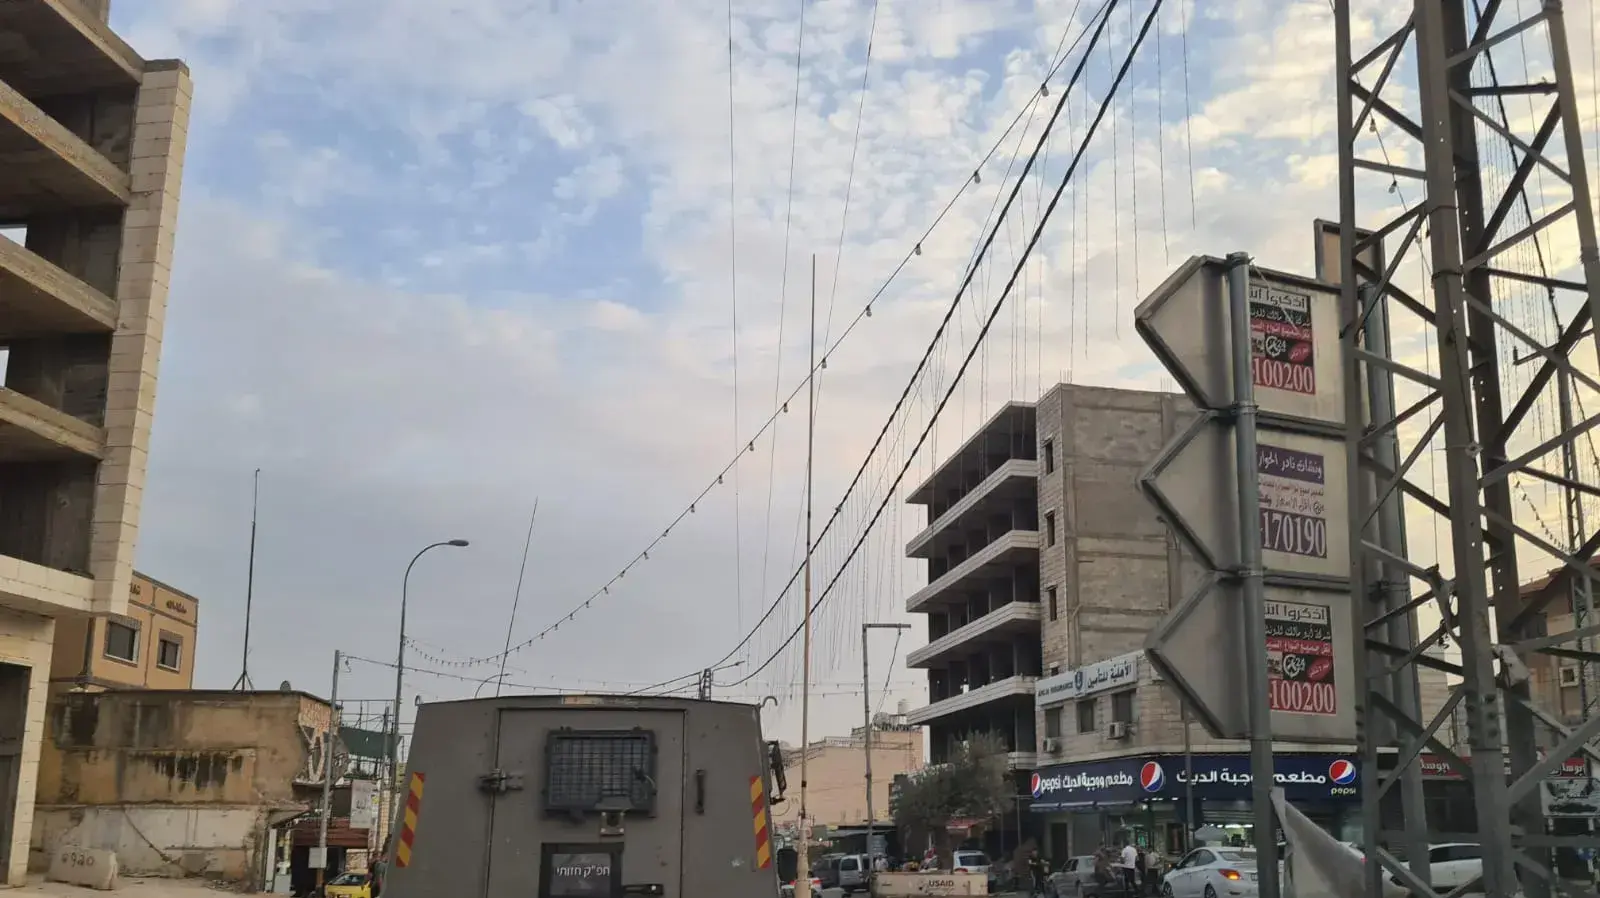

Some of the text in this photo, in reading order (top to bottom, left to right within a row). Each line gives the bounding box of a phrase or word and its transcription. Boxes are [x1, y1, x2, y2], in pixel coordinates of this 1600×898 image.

[1266, 288, 1305, 309] اذكروا
[1284, 605, 1325, 621] اذكروا
[1041, 774, 1061, 794] pepsi
[1063, 773, 1081, 792] الديك
[1105, 770, 1133, 787] مطعم
[1177, 769, 1217, 786] الديك
[1273, 770, 1326, 785] مطعم
[1331, 787, 1356, 796] pepsi
[583, 865, 610, 878] חפ"ק
[929, 879, 954, 887] USAID
